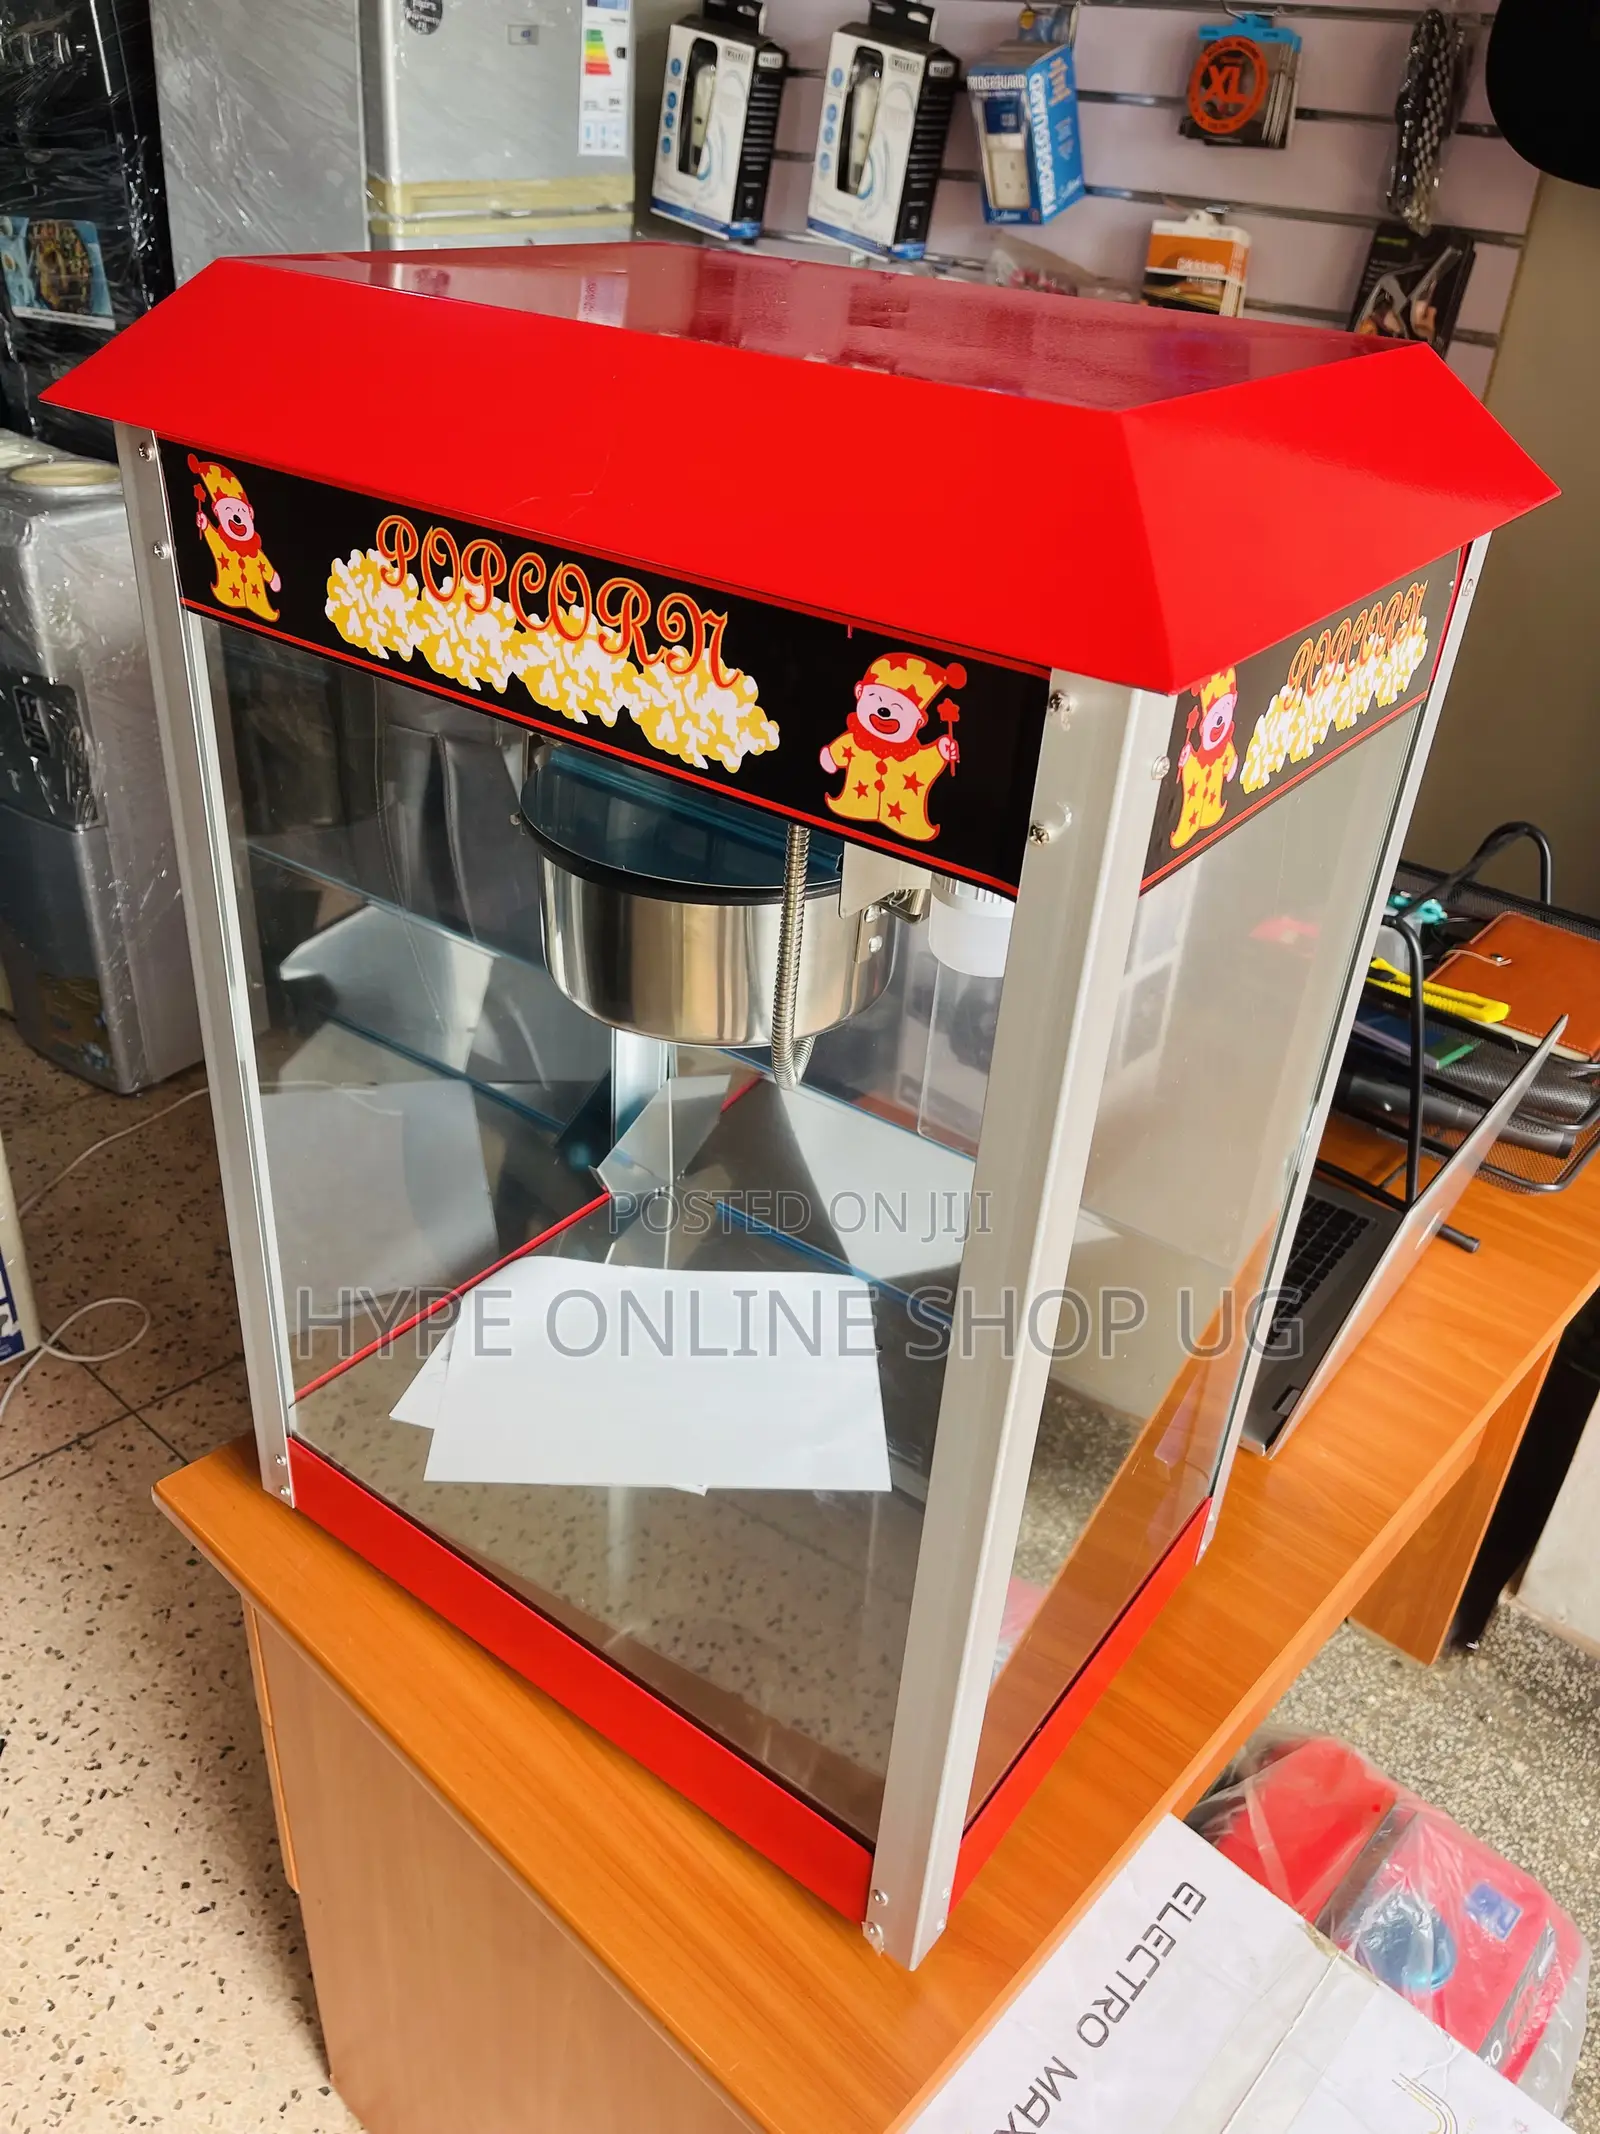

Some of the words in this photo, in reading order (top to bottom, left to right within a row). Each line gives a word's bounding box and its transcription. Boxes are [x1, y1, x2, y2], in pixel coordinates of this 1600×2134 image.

[1200, 65, 1246, 104] XL
[376, 515, 741, 690] POPCORN
[1076, 1881, 1207, 2048] ELECTRO
